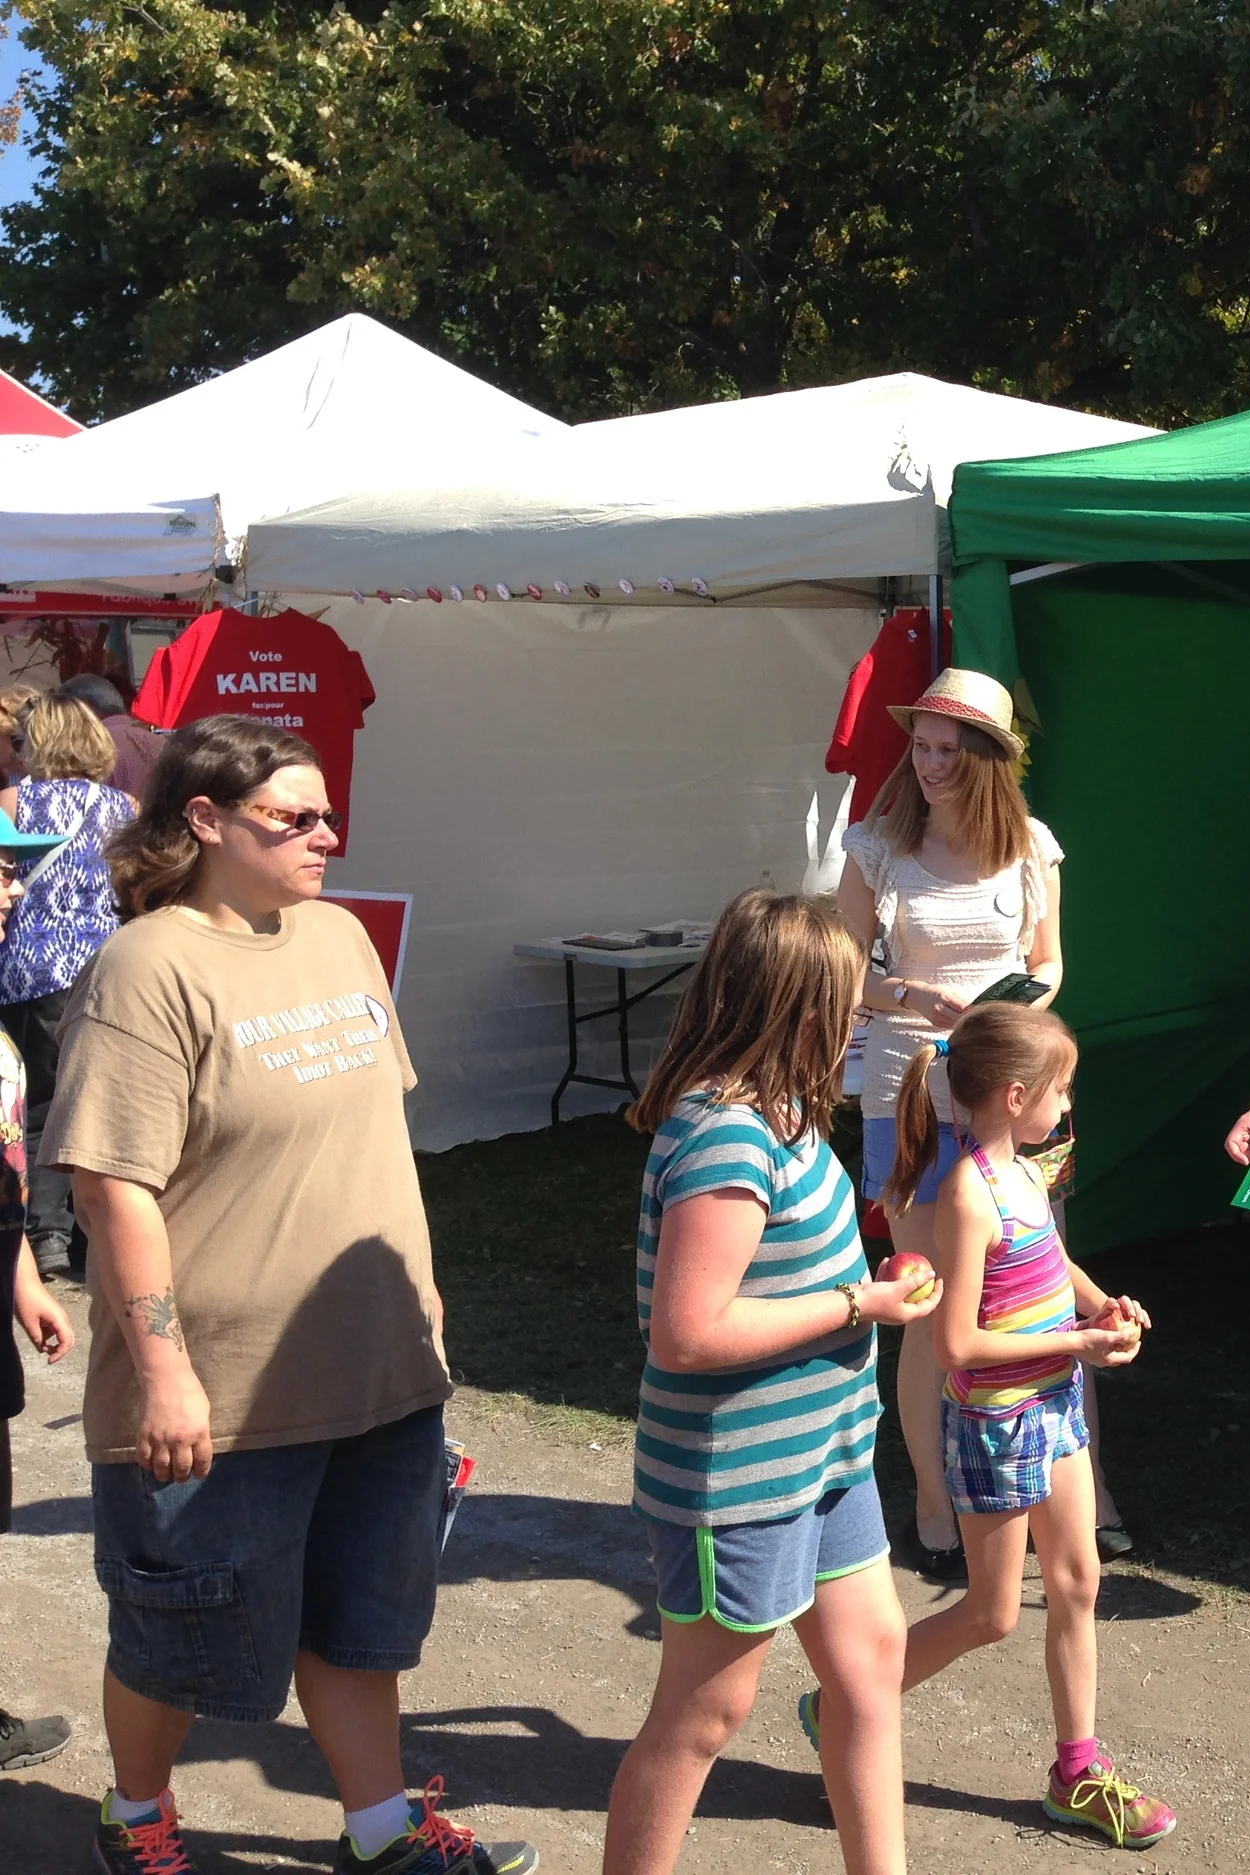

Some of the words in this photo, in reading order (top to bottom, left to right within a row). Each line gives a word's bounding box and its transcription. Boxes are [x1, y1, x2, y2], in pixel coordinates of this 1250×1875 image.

[249, 650, 283, 663] Vote
[216, 672, 317, 695] KAREN
[248, 713, 303, 727] nata
